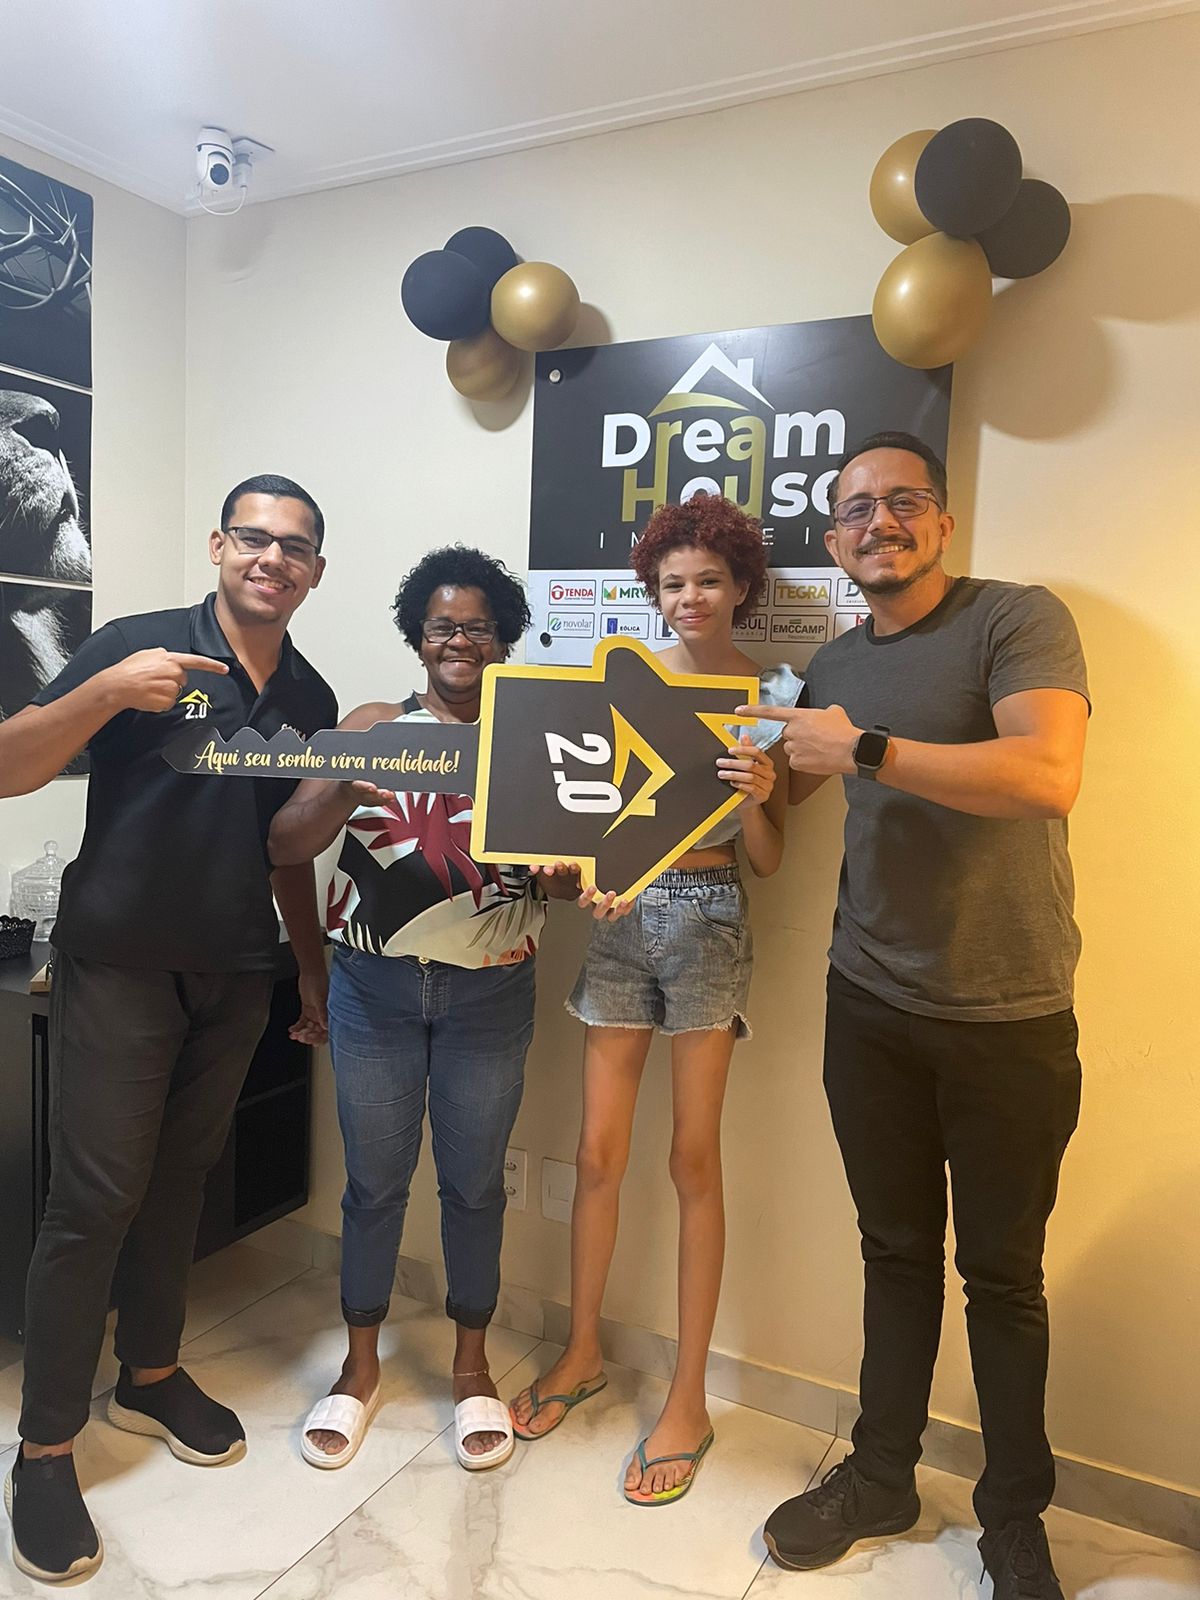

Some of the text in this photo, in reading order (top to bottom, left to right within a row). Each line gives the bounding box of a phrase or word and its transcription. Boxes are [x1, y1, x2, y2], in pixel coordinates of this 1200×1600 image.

[602, 409, 846, 467] Dream
[565, 588, 593, 597] TENDA
[777, 585, 828, 599] TEGRA
[563, 618, 592, 629] novolar
[773, 624, 825, 634] EMCCAMP
[185, 703, 207, 719] 2.0
[193, 741, 460, 775] Aqui seu sonho vira realidade!
[545, 732, 623, 814] 2.0
